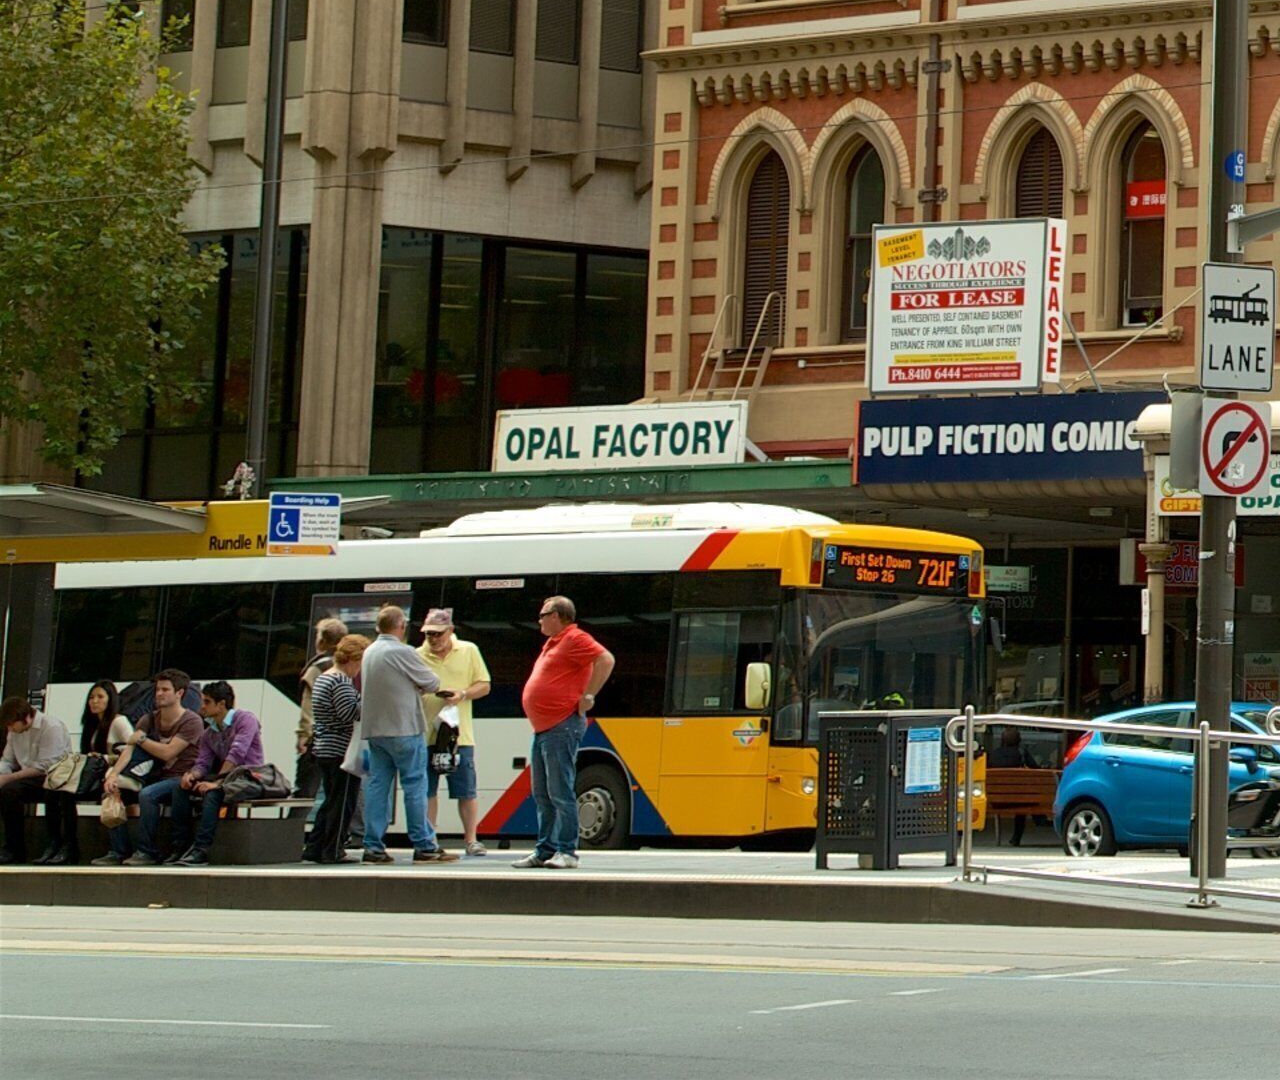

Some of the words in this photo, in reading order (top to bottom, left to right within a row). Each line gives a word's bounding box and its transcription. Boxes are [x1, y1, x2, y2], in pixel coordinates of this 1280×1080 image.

[884, 234, 917, 248] BASEMENT
[891, 245, 910, 253] LEVEL
[887, 252, 916, 262] TENANCY
[893, 260, 1026, 281] NEGOTIATORS
[899, 293, 940, 308] FOR
[949, 291, 1016, 306] LEASE
[891, 315, 907, 324] WELL
[943, 312, 956, 321] SELF
[958, 311, 989, 321] CONTAINED
[991, 310, 1022, 320] BASEMENT
[891, 328, 920, 337] TENANCY
[922, 327, 930, 335] OF
[988, 324, 1005, 333] WITH
[1007, 324, 1022, 332] OWN
[890, 341, 925, 350] ENTRANCE
[927, 340, 945, 349] FROM
[947, 339, 963, 348] KING
[965, 338, 994, 347] WILLIAM
[996, 337, 1021, 347] STREET
[1209, 344, 1266, 373] LANE
[934, 367, 960, 380] 6444
[505, 426, 580, 461] OPAL
[592, 419, 734, 458] FACTORY
[863, 425, 933, 457] PULP
[938, 423, 1045, 455] FICTION
[284, 497, 314, 505] Boarding
[315, 497, 330, 505] Help
[209, 534, 252, 551] Rundle
[841, 552, 865, 567] First
[867, 554, 884, 568] Set
[886, 555, 911, 570] Down
[856, 568, 877, 582] Stop
[881, 570, 895, 583] 26
[917, 559, 956, 587] 721F
